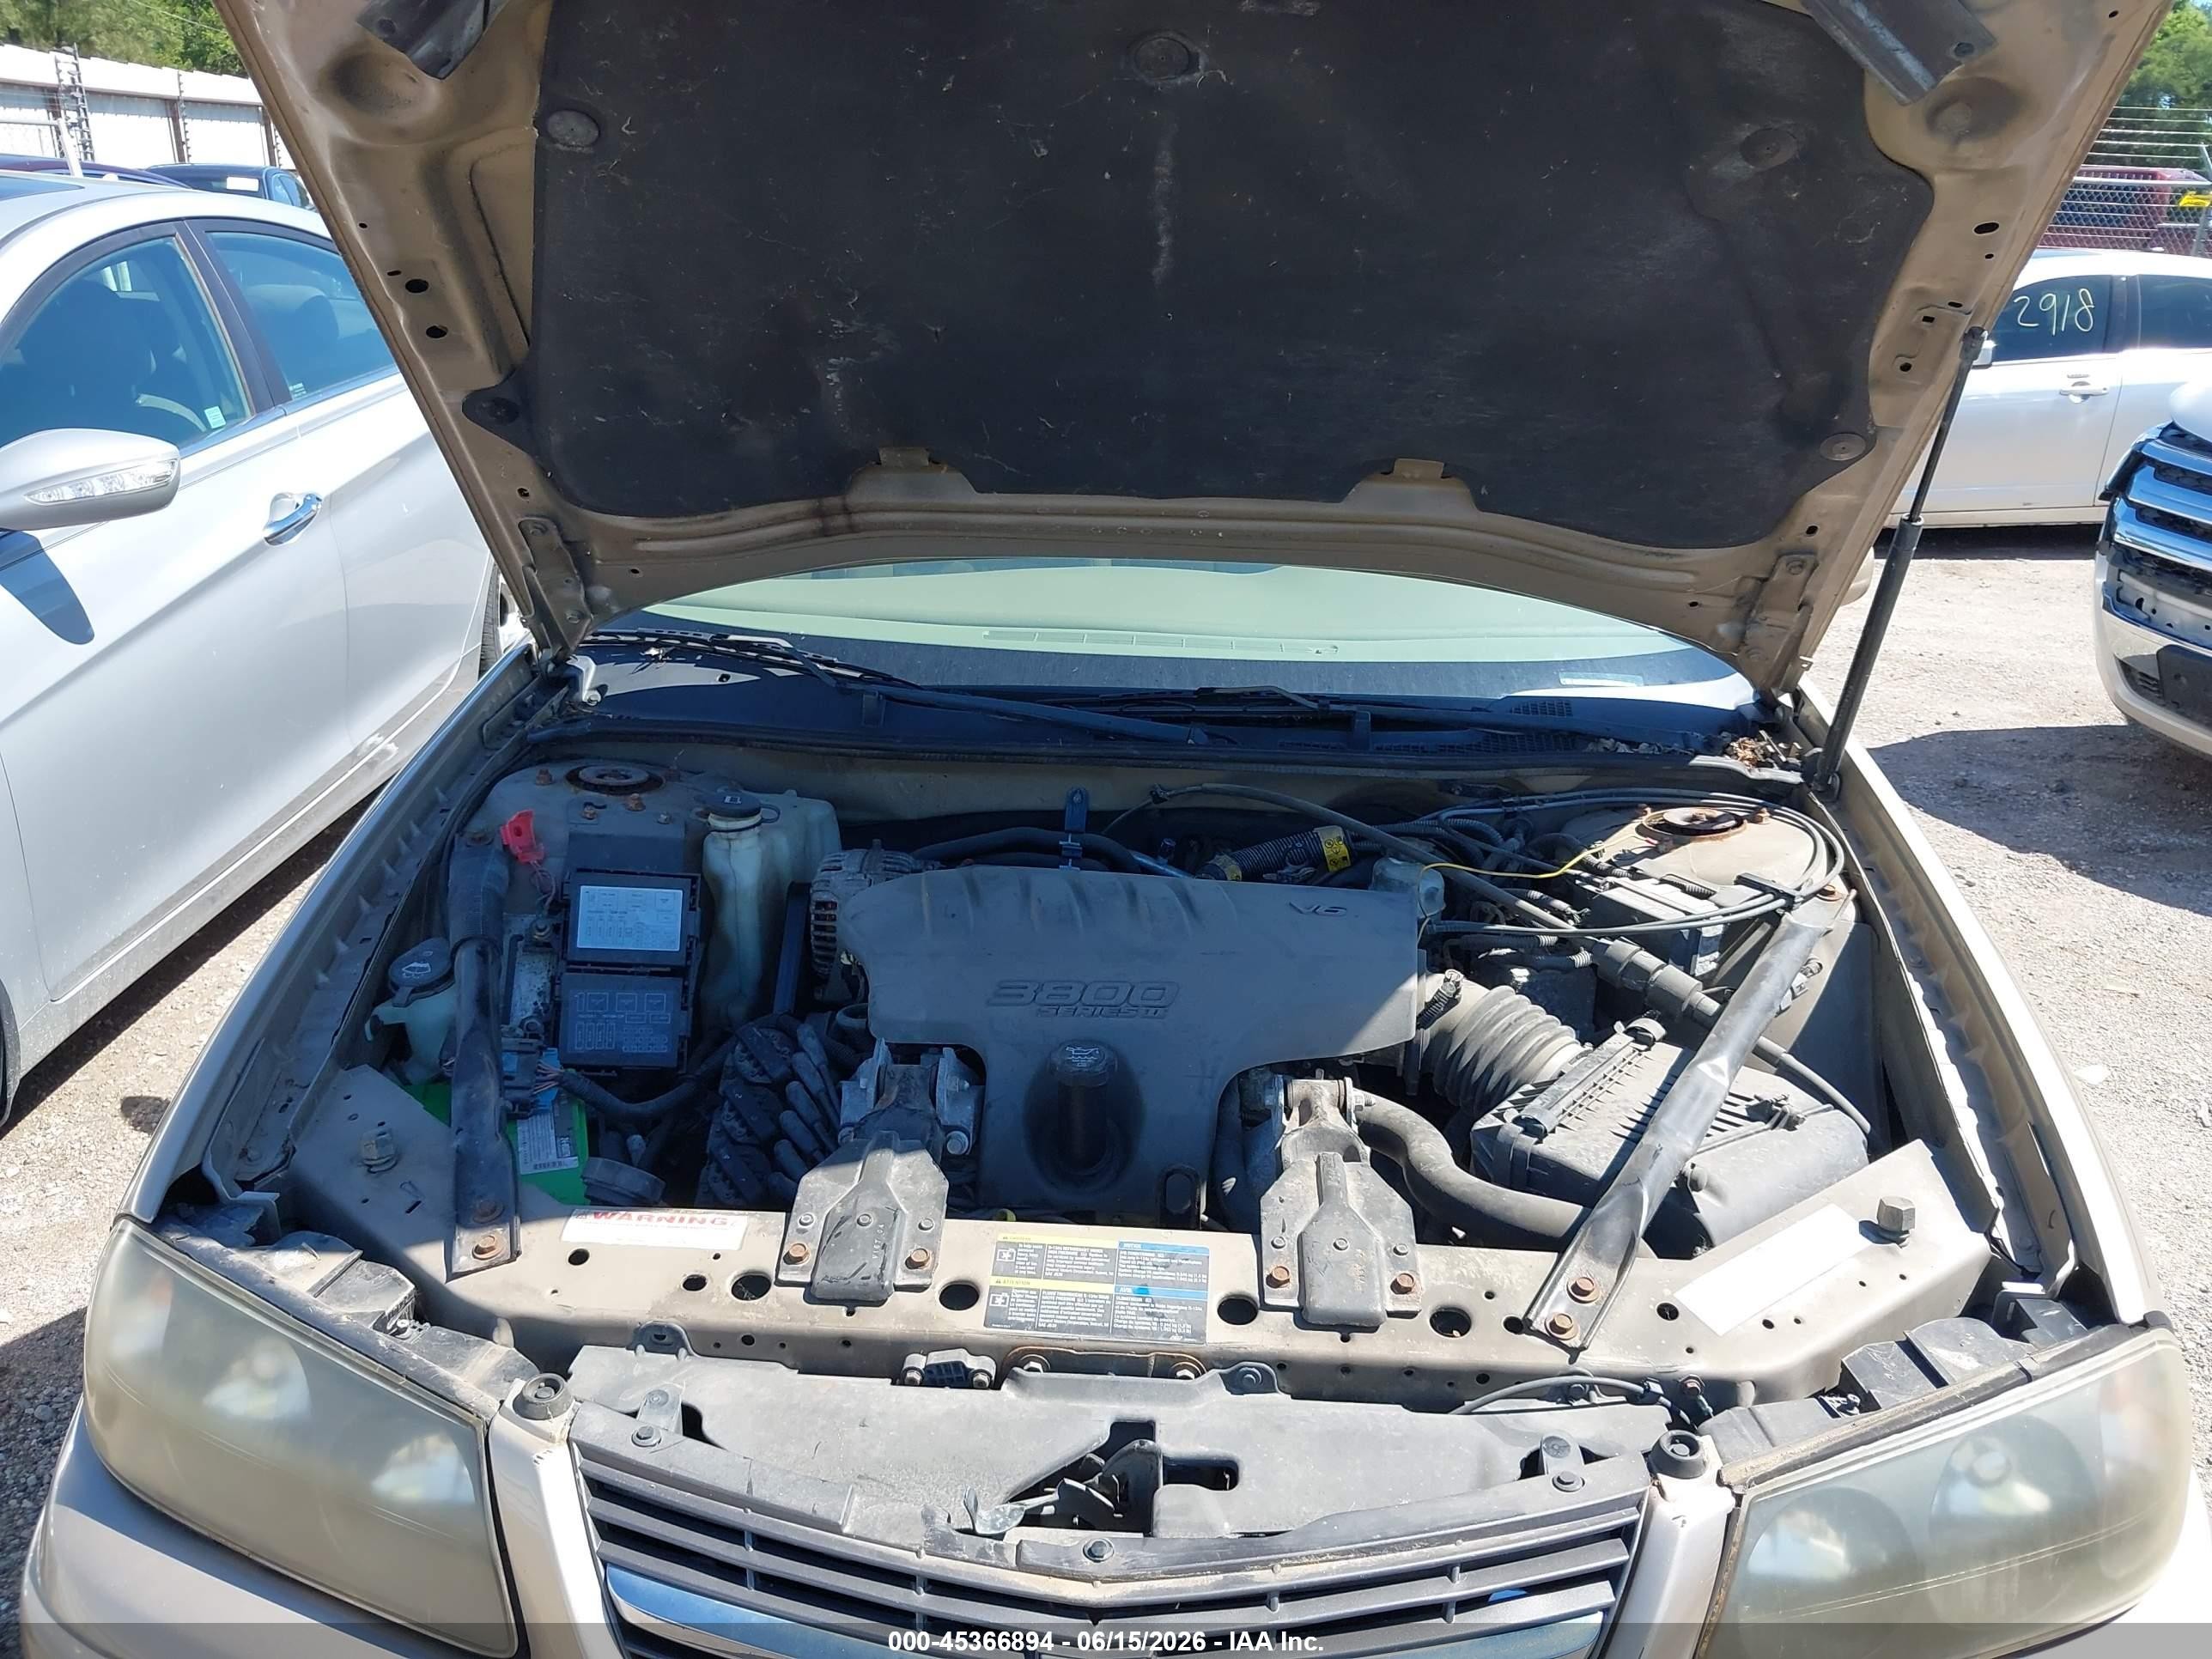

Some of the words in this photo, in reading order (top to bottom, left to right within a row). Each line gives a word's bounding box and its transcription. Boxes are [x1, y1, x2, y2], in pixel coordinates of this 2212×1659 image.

[2014, 288, 2095, 336] 2918
[987, 980, 1180, 1009] 3800
[1036, 1006, 1138, 1019] SERIES
[593, 1212, 728, 1226] WARNING
